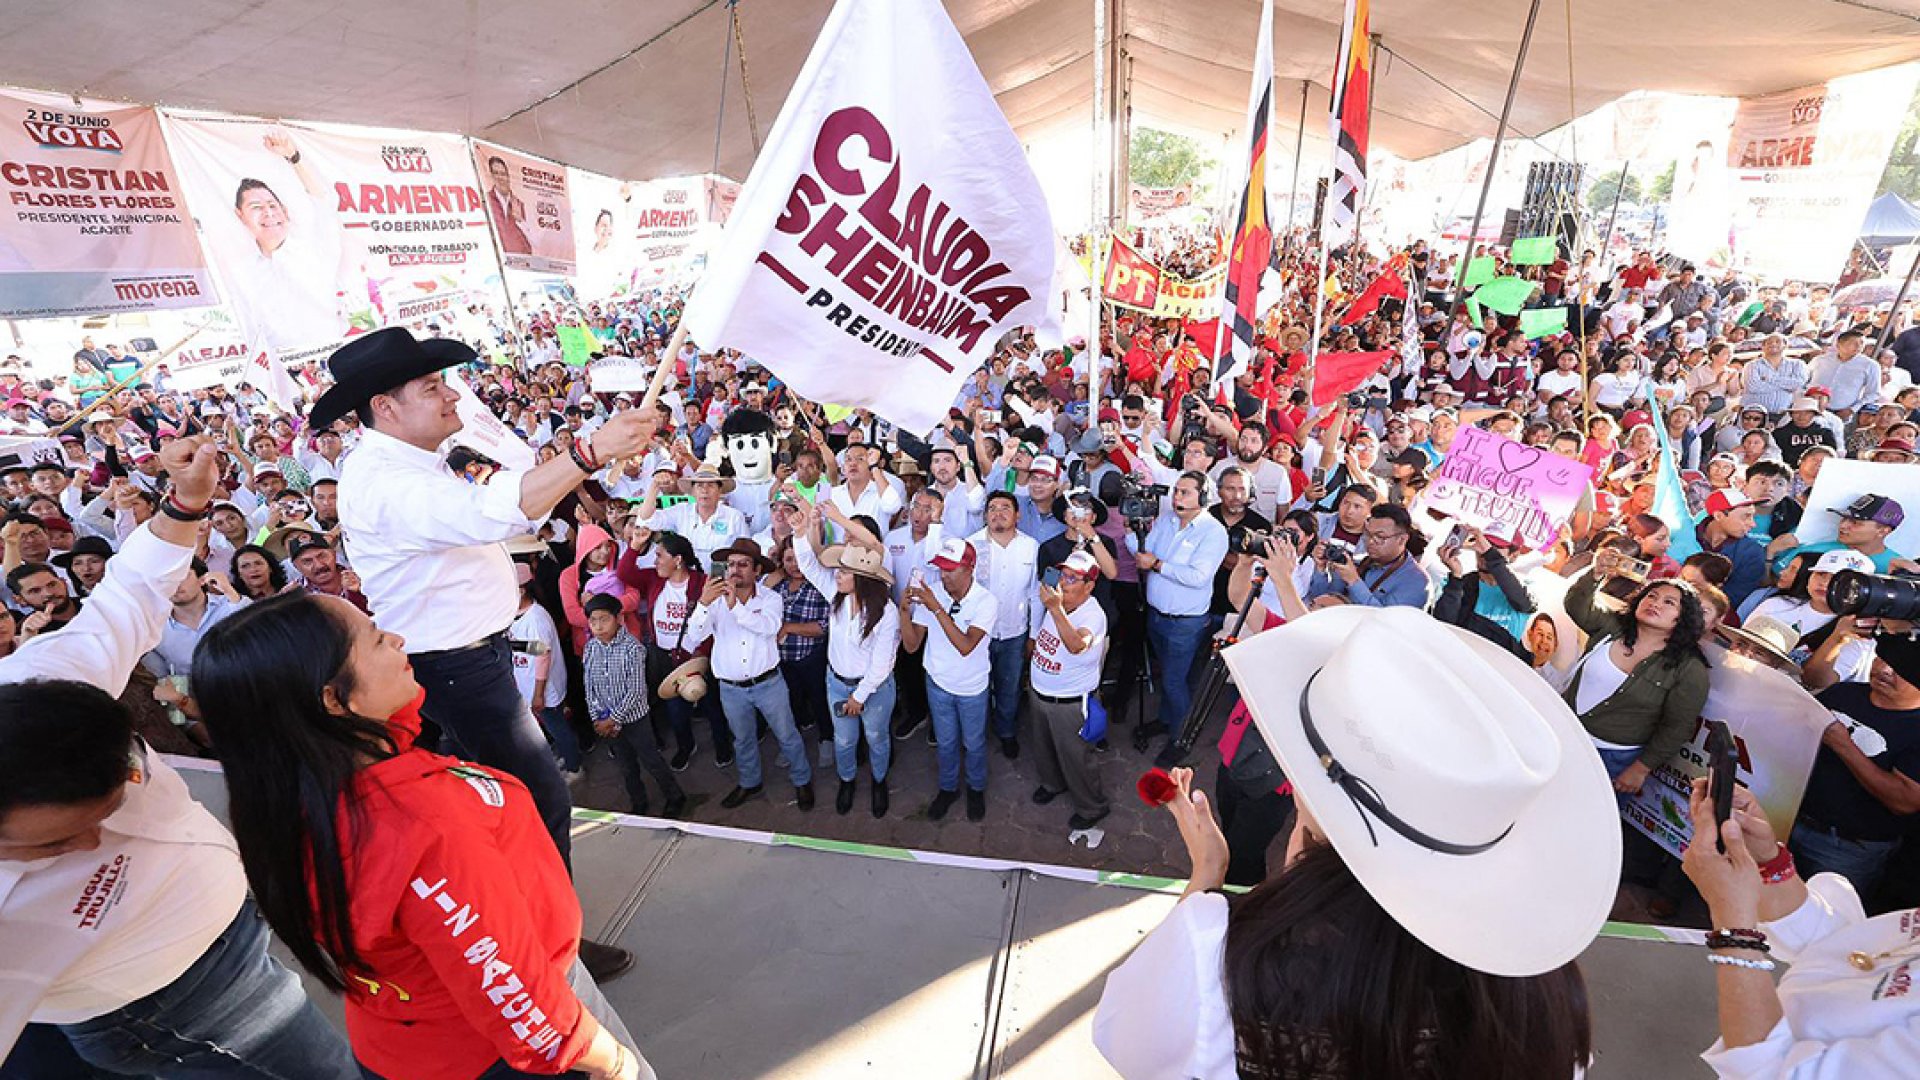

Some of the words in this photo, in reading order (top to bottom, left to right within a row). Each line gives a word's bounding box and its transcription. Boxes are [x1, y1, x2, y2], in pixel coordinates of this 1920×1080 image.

[27, 110, 37, 121] 2
[42, 111, 65, 124] DE
[68, 114, 110, 127] JUNIO
[26, 122, 122, 149] VOTA
[1, 162, 169, 192] CRISTIAN
[384, 155, 431, 172] VOTA
[10, 191, 96, 208] FLORES
[100, 195, 176, 209] FLORES
[334, 183, 482, 214] ARMENTA
[17, 212, 110, 224] PRESIDENTE
[113, 213, 182, 224] MUNICIPAL
[371, 219, 464, 232] GOBERNADOR
[813, 106, 1032, 323] CLAUDIA
[79, 225, 133, 236] ACAJETE
[774, 173, 991, 354] SHEINBAUM
[114, 279, 200, 300] morena
[1107, 263, 1154, 303] PT
[399, 299, 441, 319] morena
[1442, 454, 1534, 504] MIGUE
[73, 863, 109, 914] MIGUE
[78, 854, 123, 928] TRUJILLO
[410, 876, 480, 937] LIZ
